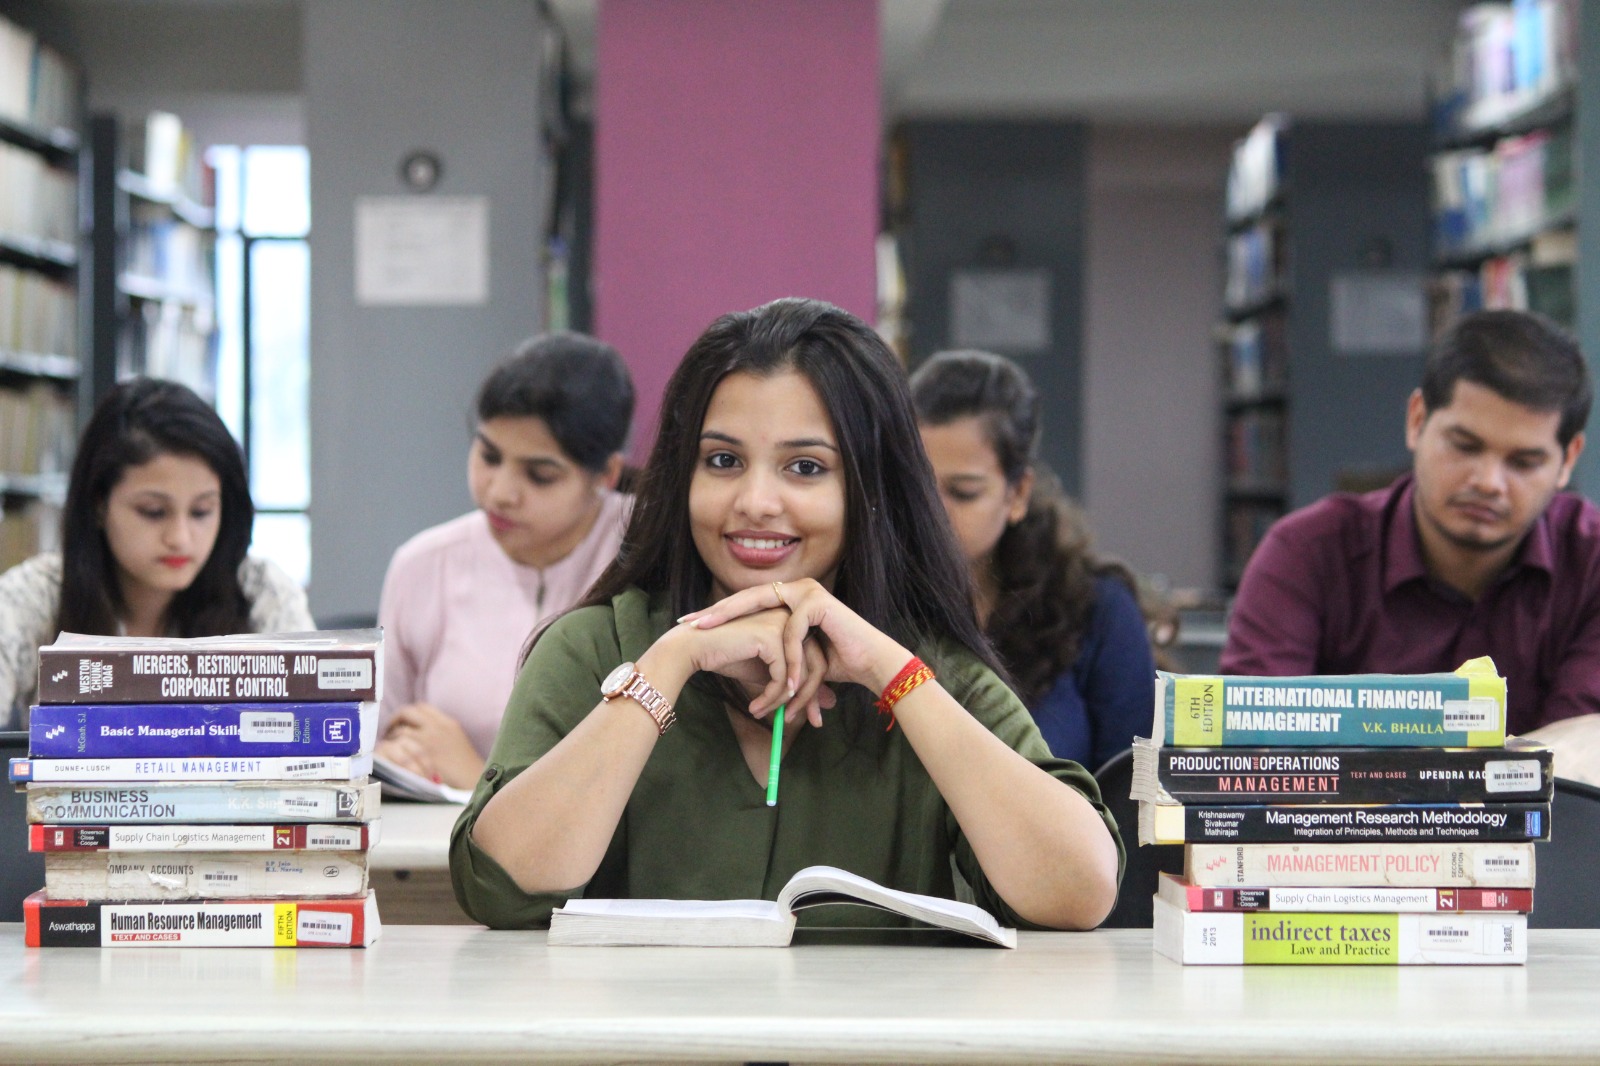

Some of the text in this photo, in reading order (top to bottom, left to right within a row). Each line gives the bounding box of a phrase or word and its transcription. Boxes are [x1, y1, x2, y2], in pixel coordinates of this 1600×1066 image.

[132, 655, 316, 677] MERGERS, RESTRUCTURING, AND
[80, 659, 90, 694] WESTON
[91, 662, 101, 691] CHUNG
[102, 665, 113, 688] HOAG
[161, 677, 288, 697] CORPORATE CONTROL
[1226, 686, 1443, 710] INTERNATIONAL FINANCIAL
[1190, 697, 1200, 719] 6TH
[1203, 684, 1214, 732] EDITION
[1226, 711, 1342, 732] MANAGEMENT
[1362, 722, 1444, 734] V.K. BHALLA
[100, 726, 134, 736] Basic
[138, 725, 205, 738] Managerial
[302, 718, 310, 744] Edition
[136, 761, 261, 774] RETAIL MANAGEMENT
[1170, 756, 1250, 770] PRODUCTION
[1260, 756, 1340, 770] OPERATIONS
[1420, 770, 1486, 780] UPENDRA KAC
[1219, 777, 1340, 792] MANAGEMENT
[71, 790, 148, 804] BUSINESS
[44, 804, 175, 818] COMMUNICATION
[1198, 811, 1244, 820] Krishnaswamy
[1266, 811, 1507, 827] Management Research Methodology
[115, 832, 266, 843] Supply Chain Logistics Management
[1205, 828, 1238, 837] Mathirajan
[1294, 827, 1479, 837] Integration of Principles, Methods and Techniques
[110, 865, 194, 874] OMPANY ACCOUNTS
[1267, 854, 1440, 872] MANAGEMENT POLICY
[1275, 894, 1428, 904] Supply Chain Logistics Management
[49, 922, 96, 933] Aswathappa
[111, 912, 262, 932] Human Resource Management
[1252, 920, 1390, 942] indirect taxes
[1291, 944, 1390, 956] Law and Practice
